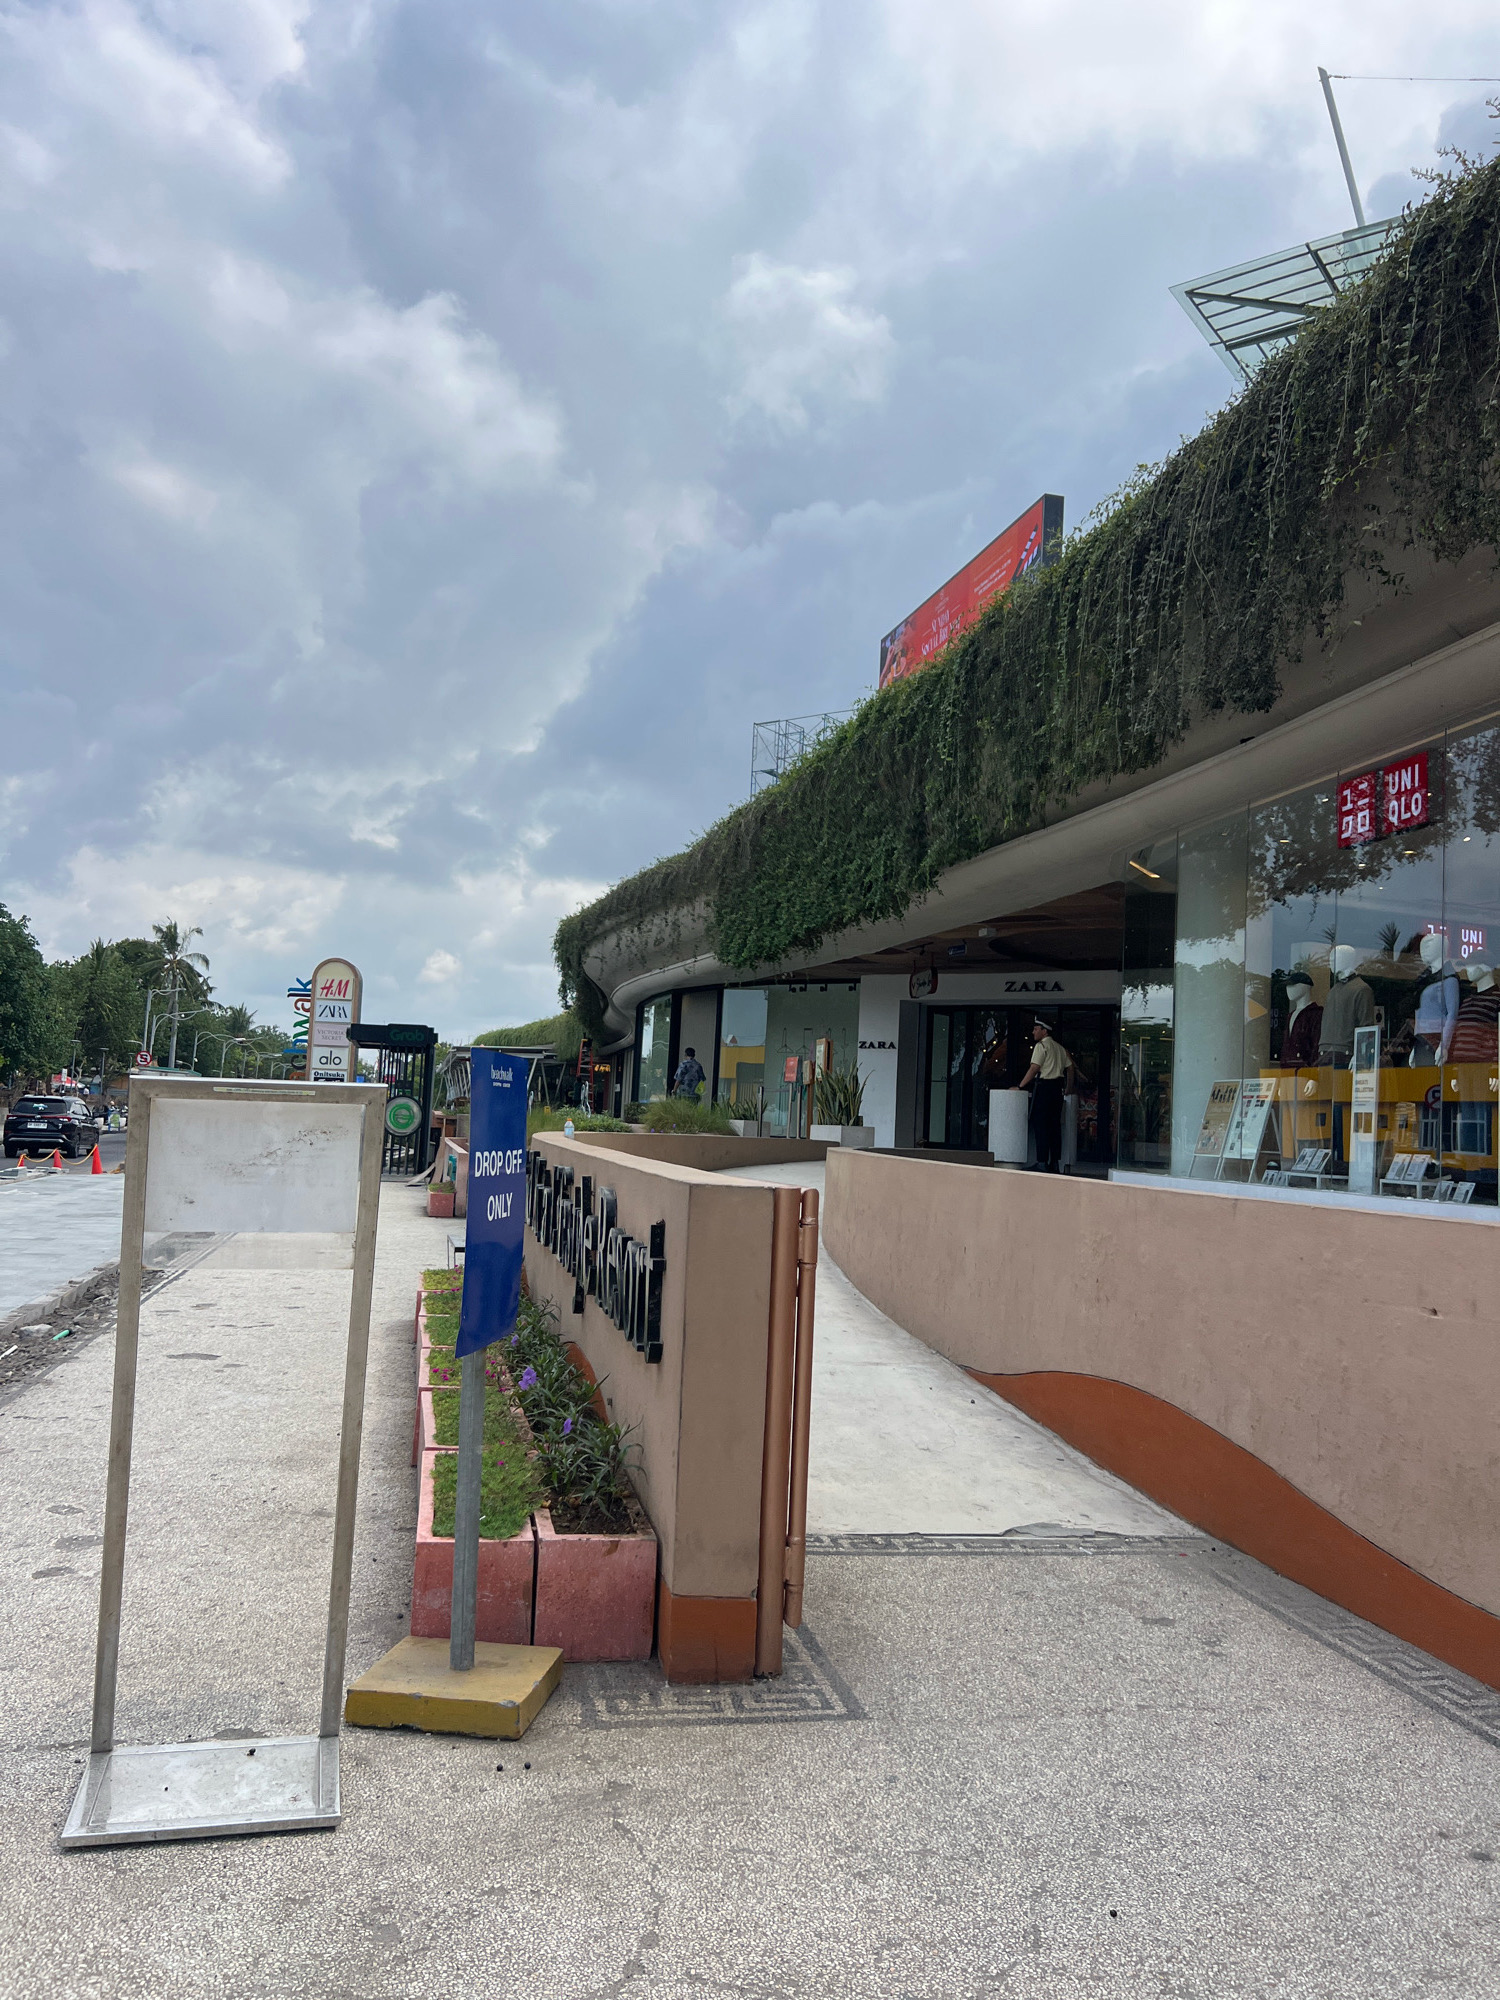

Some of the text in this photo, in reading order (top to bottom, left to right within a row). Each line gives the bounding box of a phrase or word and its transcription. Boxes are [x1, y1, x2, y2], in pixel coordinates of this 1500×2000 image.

[1388, 763, 1420, 795] UNI
[1388, 792, 1422, 826] QLO
[320, 978, 350, 998] H&M
[1004, 981, 1064, 993] ZARA
[318, 1004, 348, 1019] ZARA
[389, 1027, 425, 1042] Grab
[858, 1041, 897, 1050] ZARA
[319, 1050, 342, 1066] alo
[474, 1149, 523, 1178] DROP OFF
[487, 1192, 513, 1222] ONLY
[595, 1186, 666, 1364] Resort
